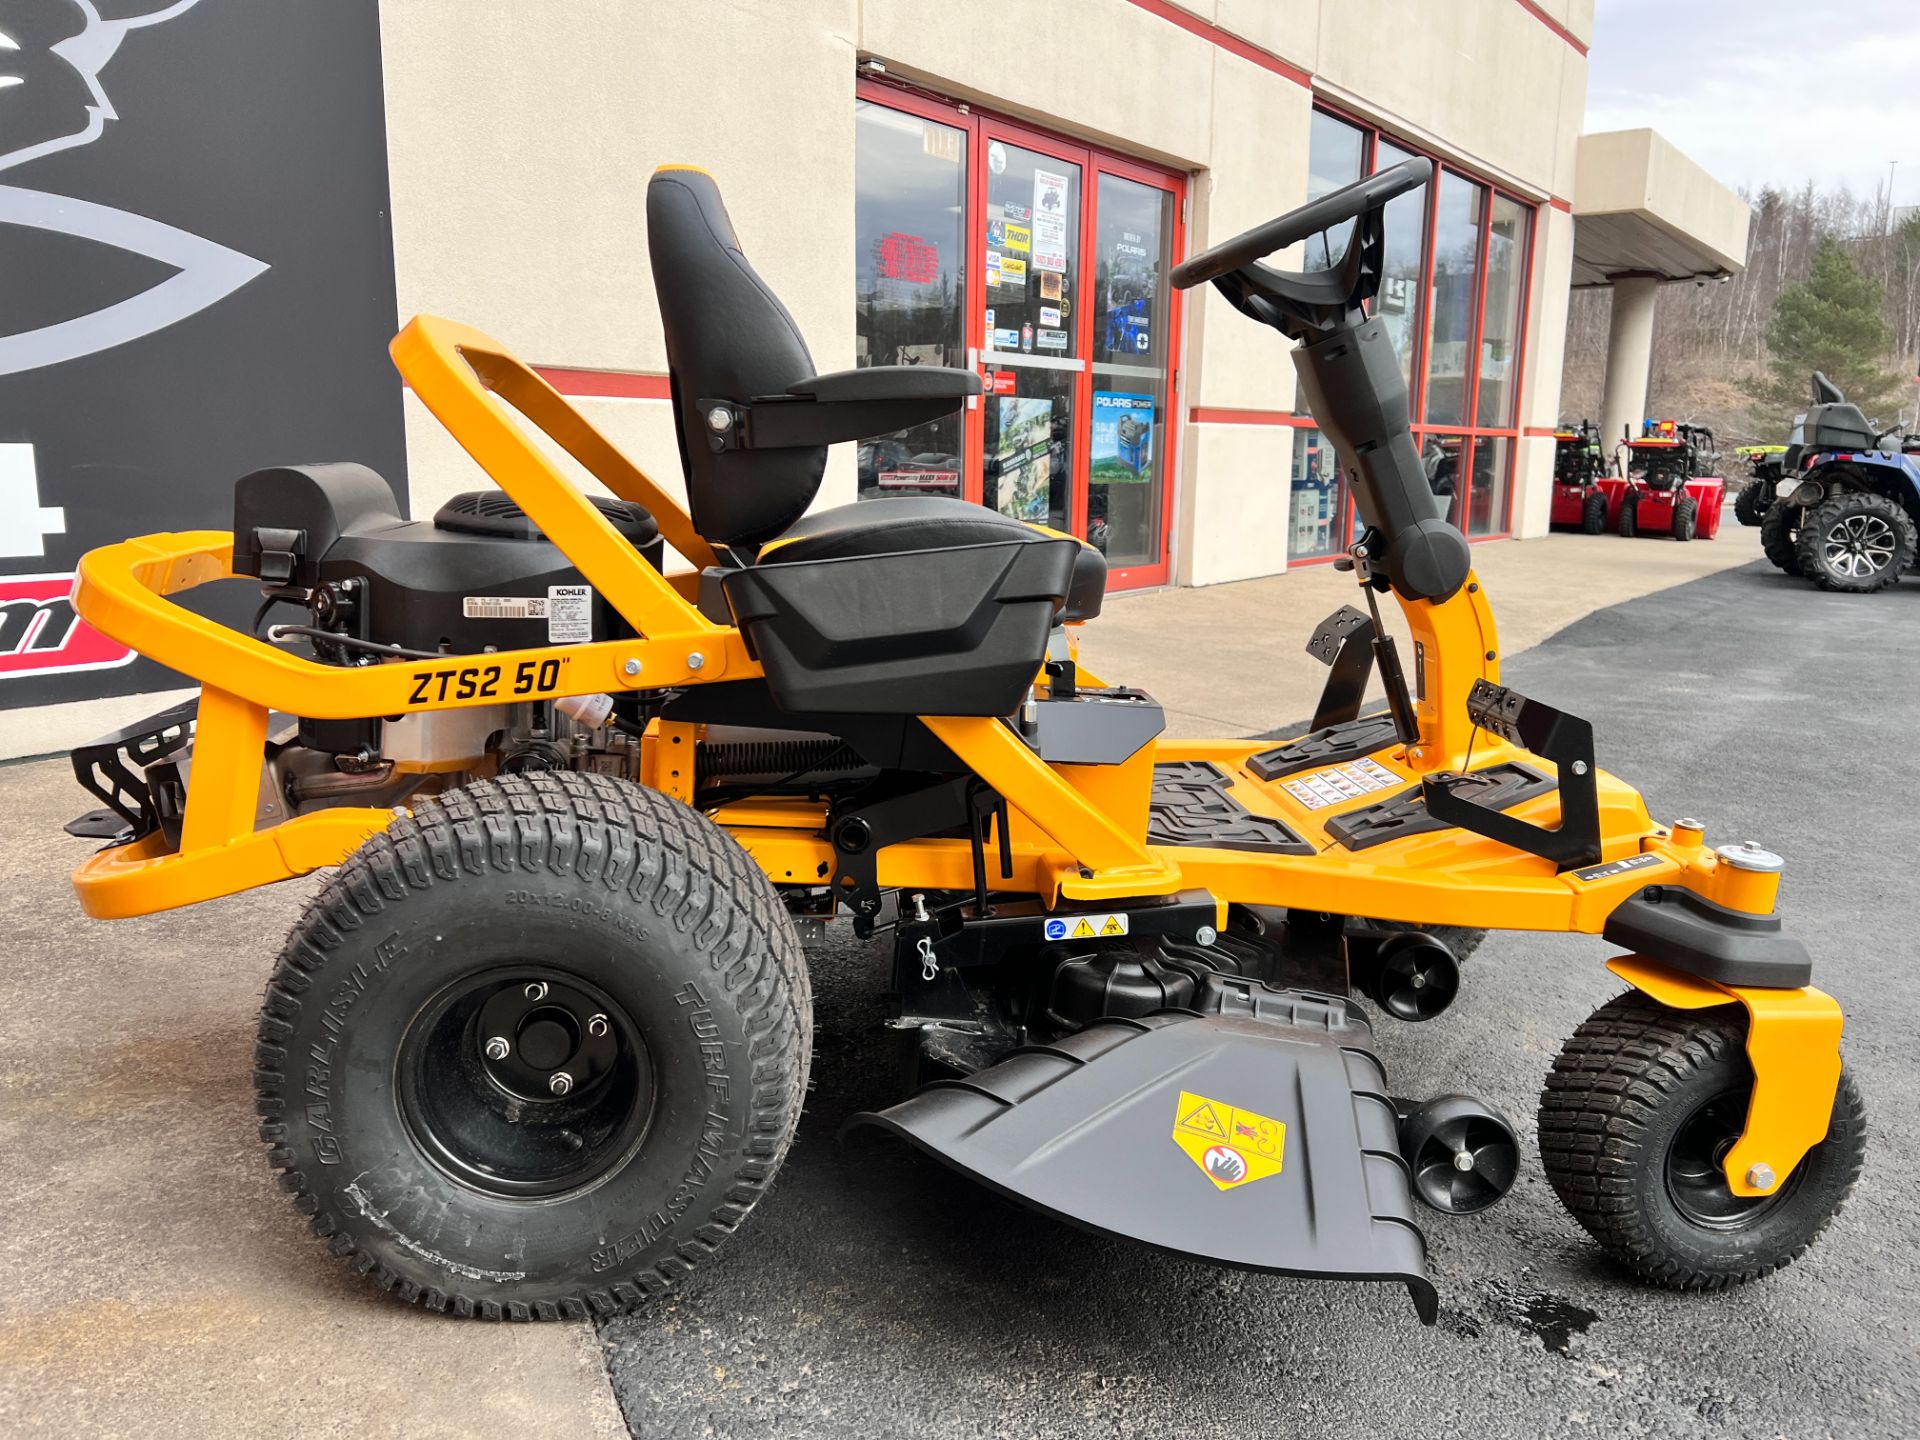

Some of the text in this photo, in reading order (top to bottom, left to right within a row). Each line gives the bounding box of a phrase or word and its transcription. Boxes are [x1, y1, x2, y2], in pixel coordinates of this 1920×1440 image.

[1007, 229, 1028, 244] THOR
[1116, 243, 1147, 257] POLARIS
[1096, 396, 1152, 408] POLARIS POWER
[1095, 422, 1115, 432] SOLD
[556, 588, 586, 596] KOHLER
[408, 657, 570, 704] ZTS2 50"
[589, 979, 731, 1273] TURF MASTER
